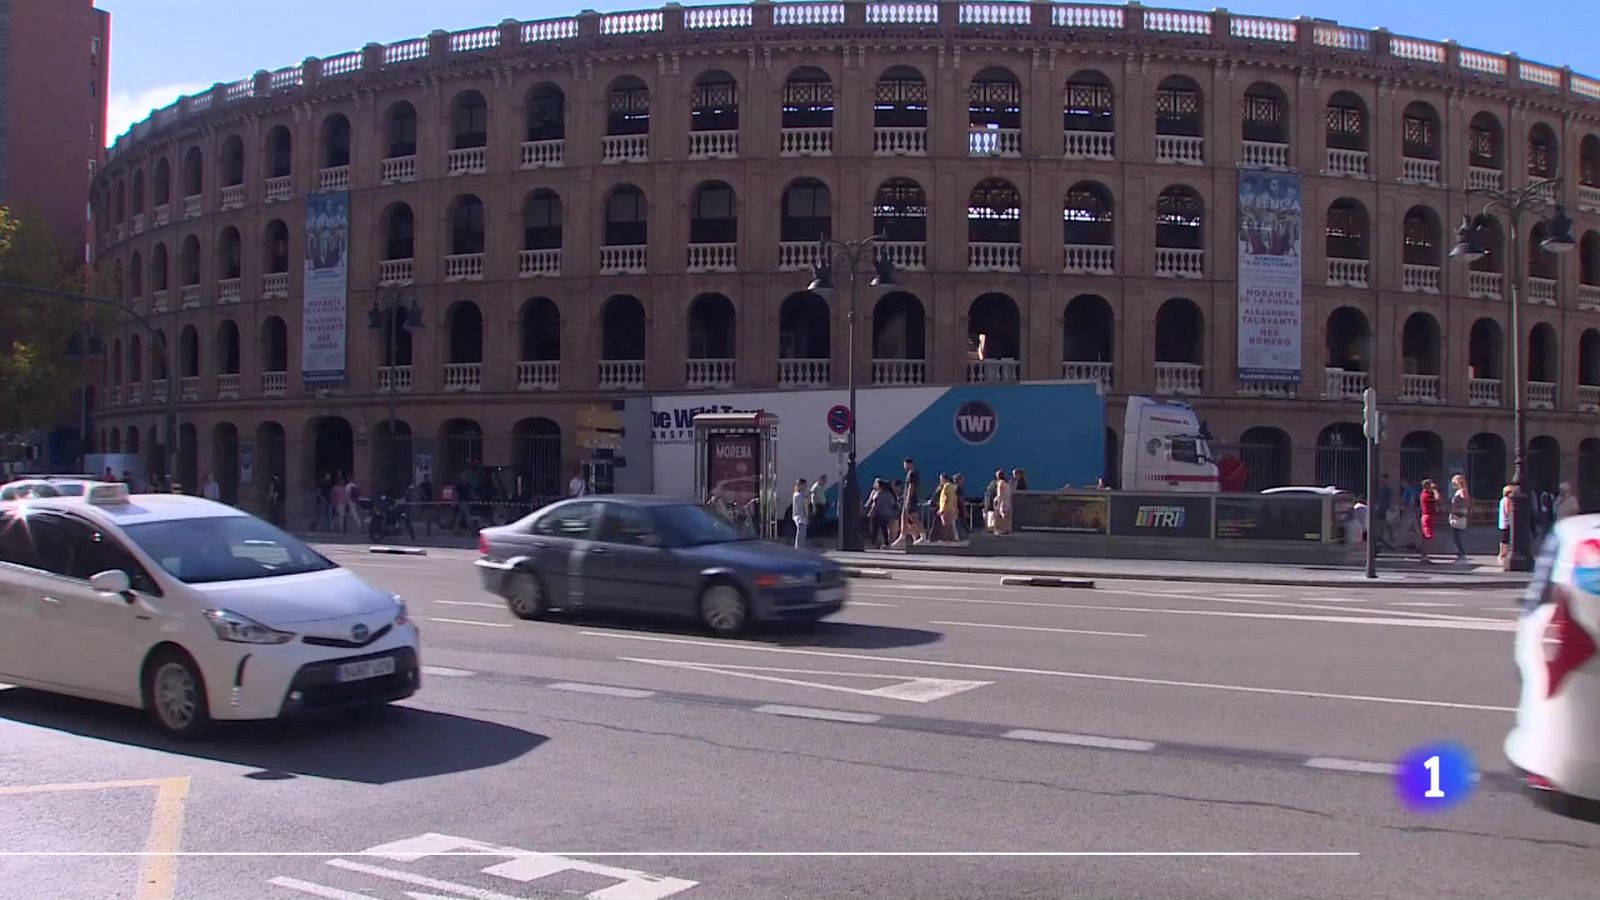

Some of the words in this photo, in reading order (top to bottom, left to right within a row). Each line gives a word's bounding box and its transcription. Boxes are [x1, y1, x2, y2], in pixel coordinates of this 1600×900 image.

[1246, 289, 1294, 298] MORANTE
[1244, 308, 1296, 317] ALEJANDRO
[1242, 316, 1299, 326] TALAVANTE
[1249, 337, 1291, 346] ROMERO
[958, 415, 993, 432] TWT
[651, 429, 693, 439] ANSPO
[716, 445, 752, 459] MORENA
[1153, 511, 1180, 527] TRI
